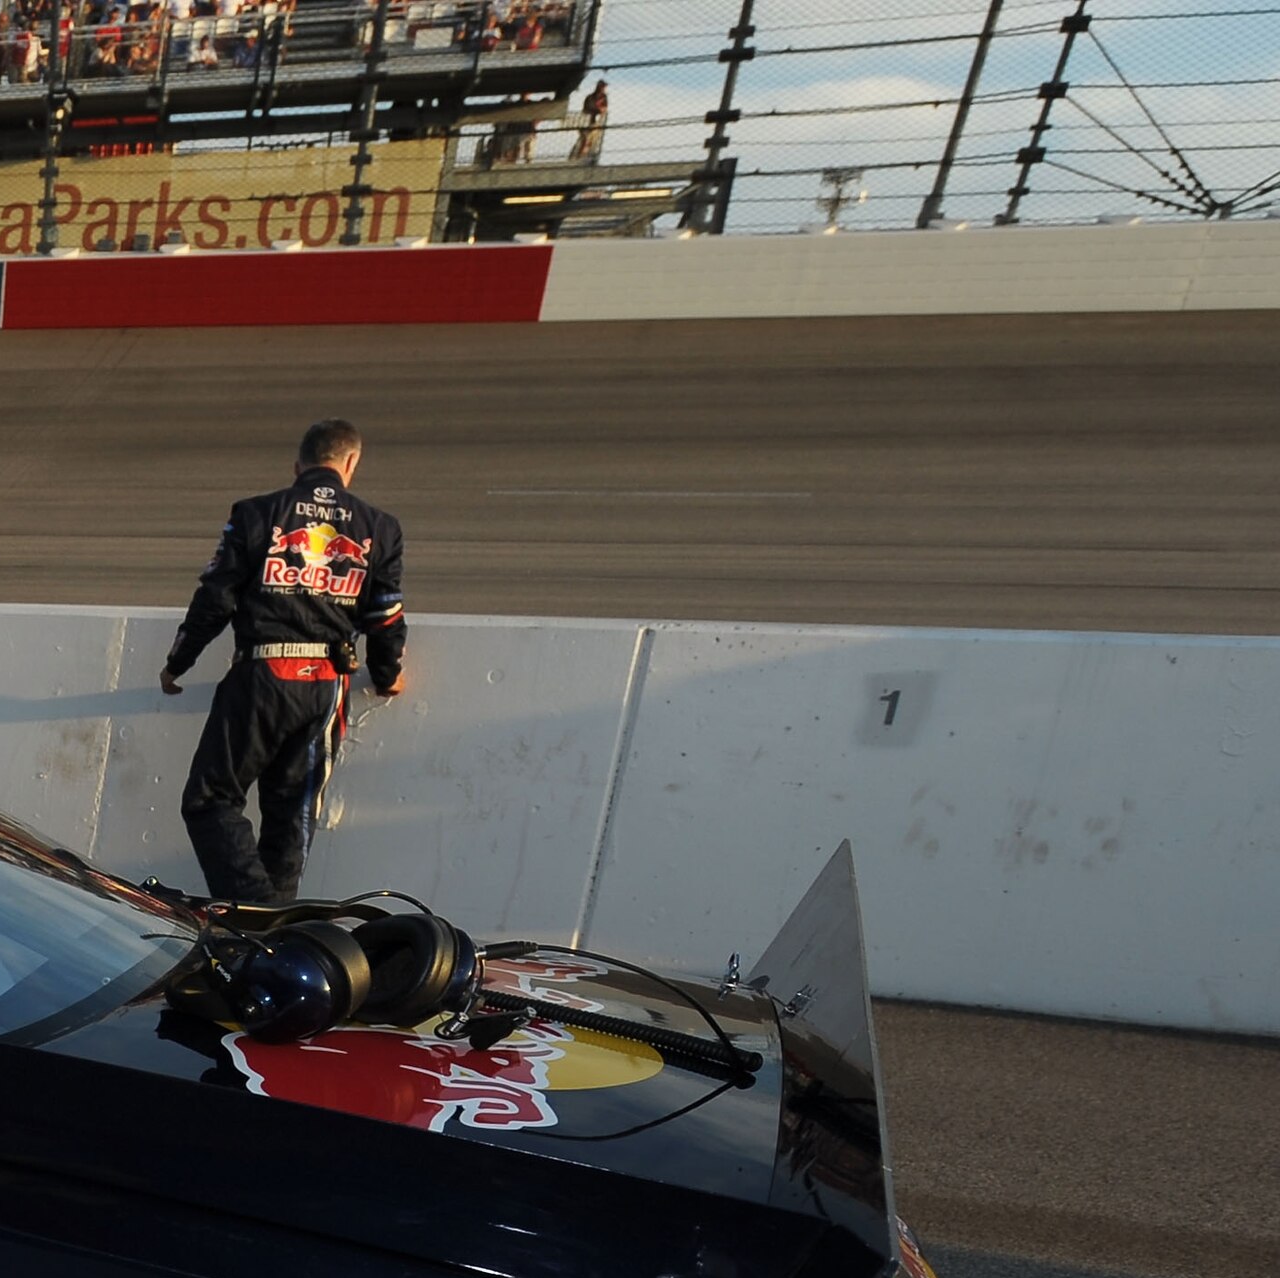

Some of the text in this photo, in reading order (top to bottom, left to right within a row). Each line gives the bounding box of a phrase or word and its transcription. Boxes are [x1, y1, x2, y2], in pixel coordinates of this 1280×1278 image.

[262, 557, 367, 597] Red Bull
[879, 690, 901, 726] 1
